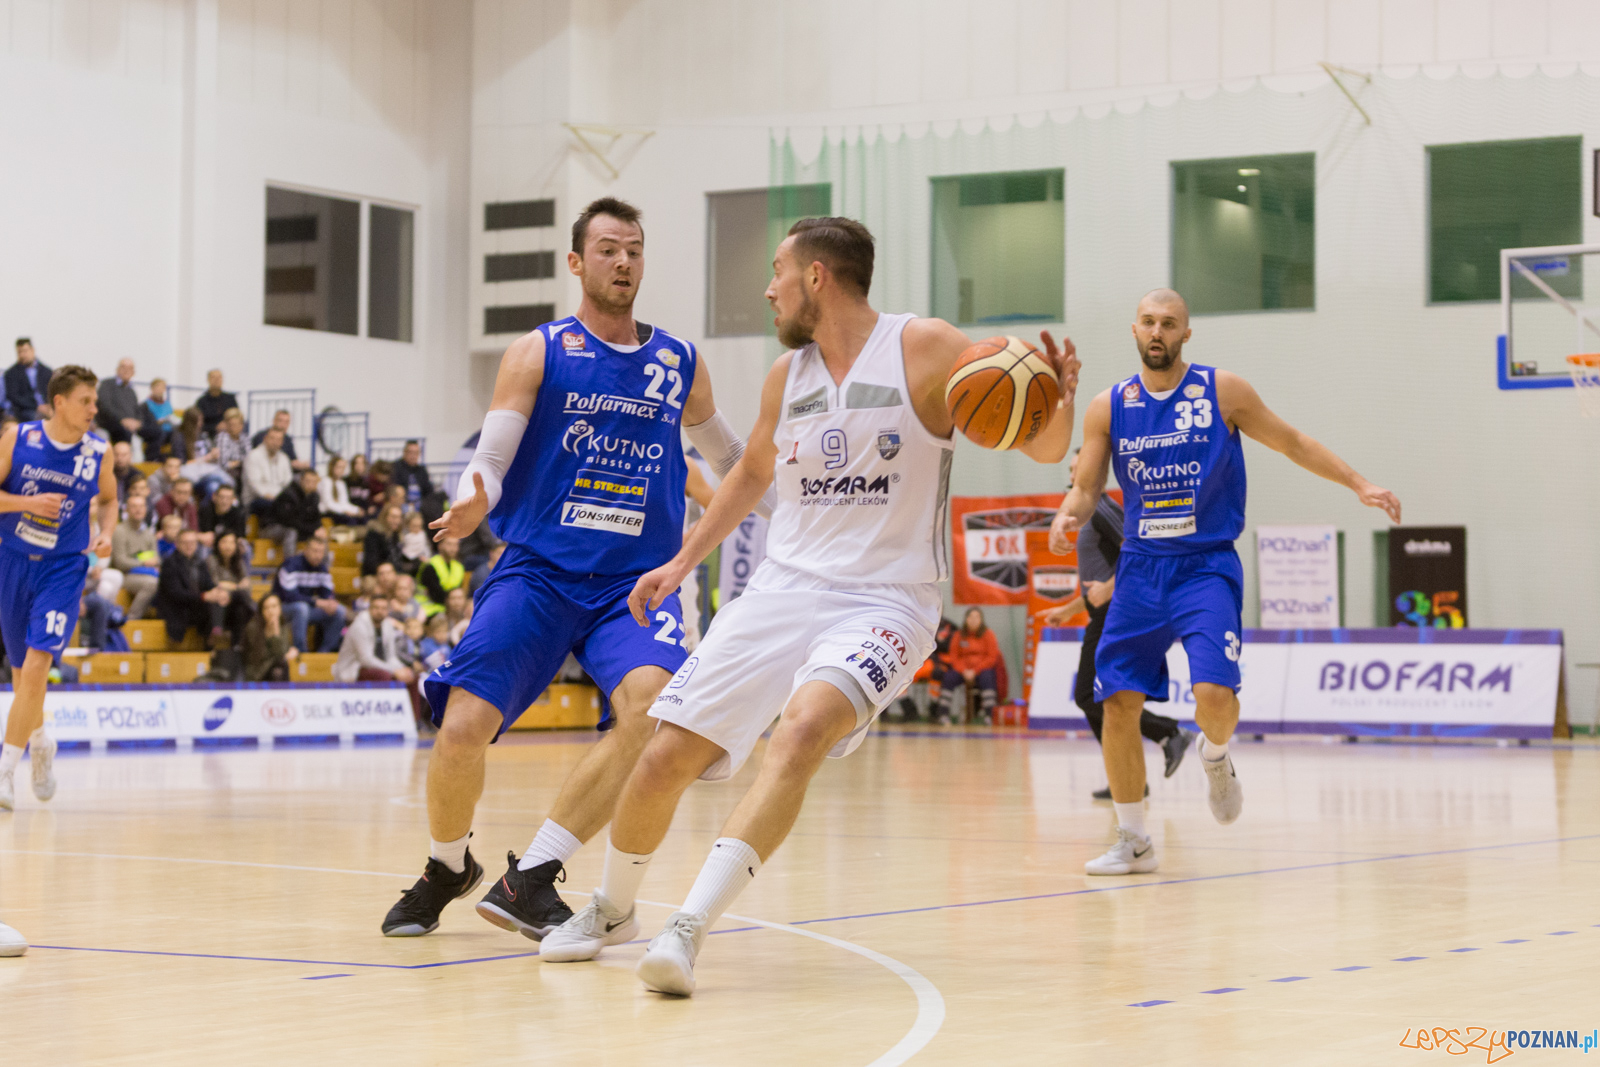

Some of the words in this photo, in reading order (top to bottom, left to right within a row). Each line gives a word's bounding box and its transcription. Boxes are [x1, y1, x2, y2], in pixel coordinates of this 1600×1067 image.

[644, 363, 683, 409] 22
[563, 391, 659, 420] Polfarmex
[1175, 399, 1212, 430] 33
[587, 434, 664, 460] KUTNO
[821, 428, 848, 470] 9
[1119, 433, 1190, 453] Polfarmex
[73, 456, 97, 481] 13
[586, 456, 631, 470] miasto
[1143, 461, 1201, 480] KUTNO
[574, 478, 591, 488] HR
[593, 480, 645, 496] STRZELCE
[858, 496, 889, 506] LEKÓW
[46, 610, 67, 637] 13
[880, 629, 906, 659] KIA
[1225, 631, 1240, 661] 3
[669, 657, 699, 689] 9
[861, 640, 898, 679] DELIK
[858, 657, 888, 693] PBG
[1319, 660, 1513, 692] BIOFARM
